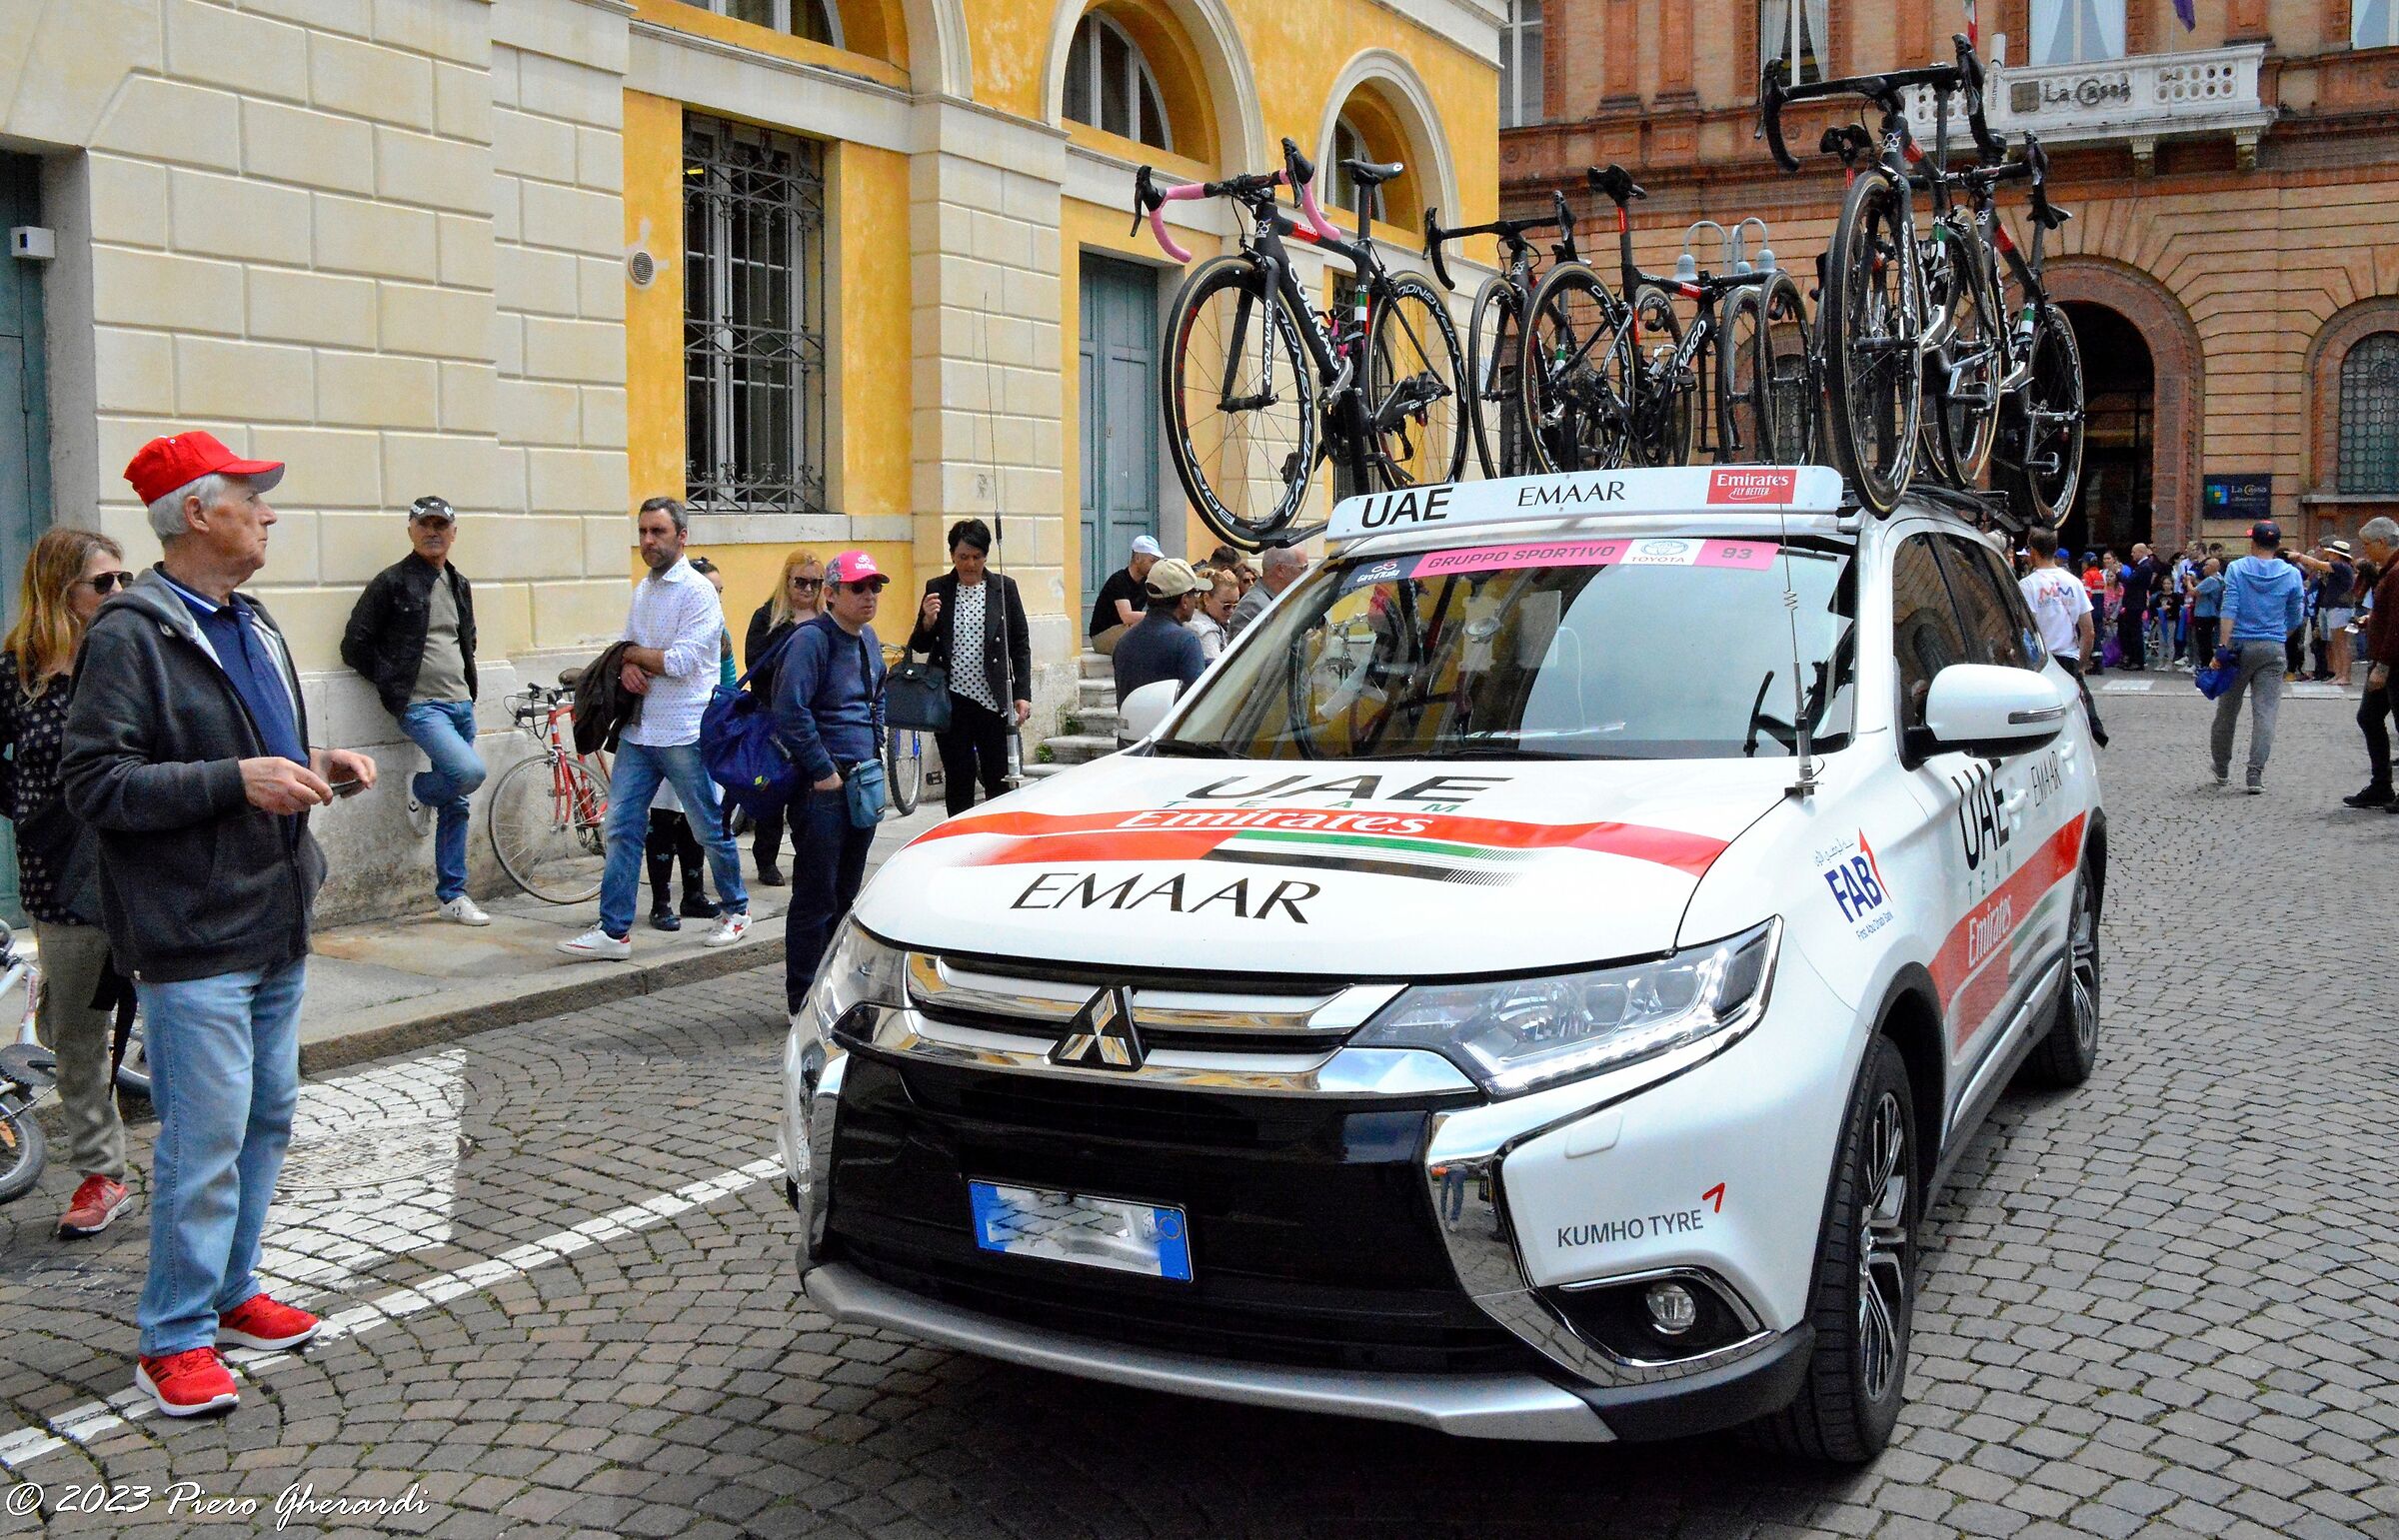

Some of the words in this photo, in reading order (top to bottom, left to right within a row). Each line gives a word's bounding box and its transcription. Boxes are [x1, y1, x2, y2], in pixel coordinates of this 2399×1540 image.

[1263, 299, 1272, 375] COLNAGO
[1287, 261, 1341, 376] COLNAG
[1517, 481, 1625, 507] EMAAR
[1716, 473, 1789, 487] Emirates
[1733, 487, 1744, 496] FLY
[1745, 487, 1771, 496] BETTER
[1360, 487, 1453, 529] UAE
[1428, 551, 1508, 569] GRUPPO
[1512, 546, 1615, 561] SPORTIVO
[1631, 556, 1685, 565] TOYOTA
[1721, 547, 1753, 561] 93
[1187, 774, 1511, 802] UAE
[2031, 751, 2061, 807] EMAAR
[1116, 806, 1435, 836] Emirates
[1951, 757, 2009, 870] UAE
[1011, 872, 1321, 924] EMAAR
[1824, 855, 1882, 924] FAB
[1968, 893, 2012, 969] Emirates
[1557, 1218, 1644, 1248] KUMHO
[1648, 1209, 1704, 1236] TYRE
